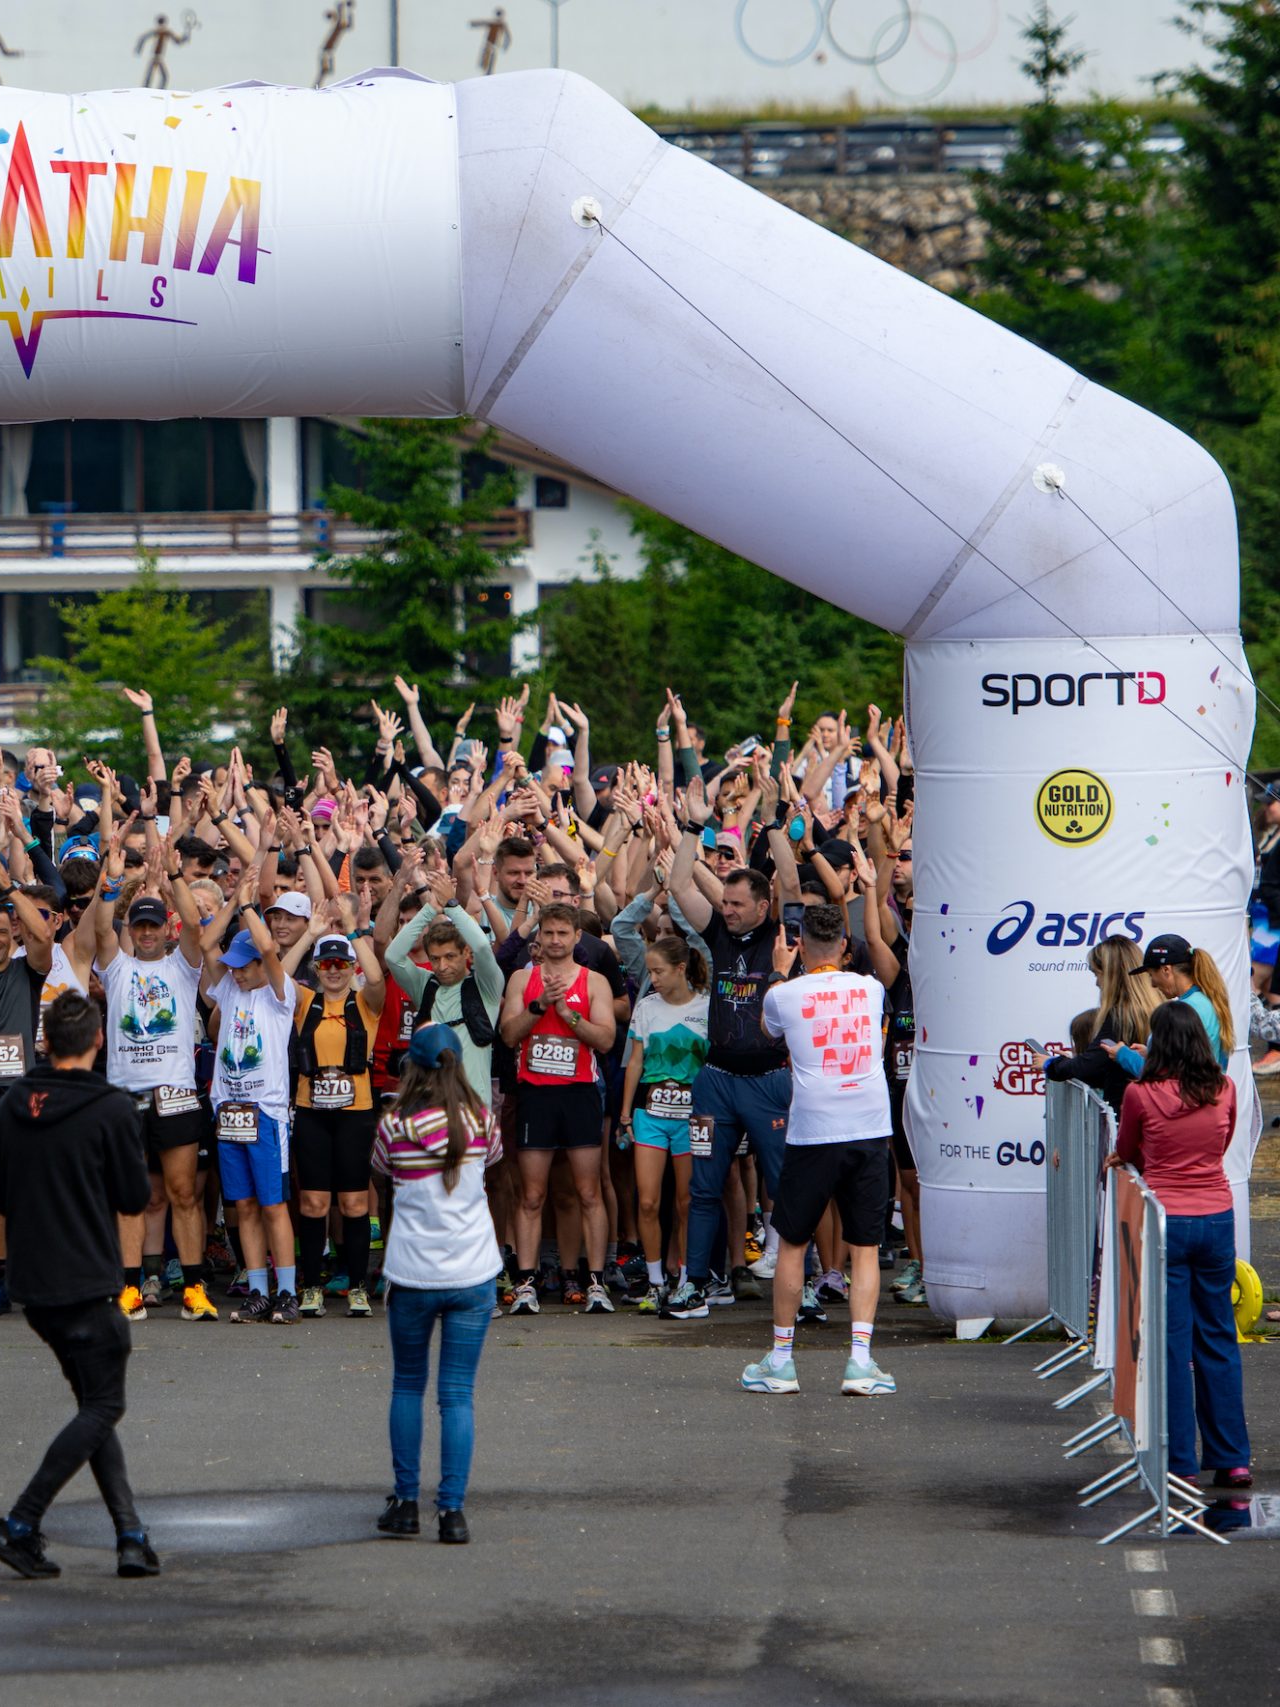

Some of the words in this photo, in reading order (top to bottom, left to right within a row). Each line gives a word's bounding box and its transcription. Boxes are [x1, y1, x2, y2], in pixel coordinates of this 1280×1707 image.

[1048, 785, 1099, 803] GOLD
[1044, 804, 1104, 817] NUTRITION
[1028, 960, 1065, 972] sound
[532, 1043, 575, 1062] 6288
[651, 1088, 692, 1105] 6328
[220, 1111, 255, 1127] 6283
[940, 1143, 961, 1158] FOR
[963, 1145, 990, 1159] THE
